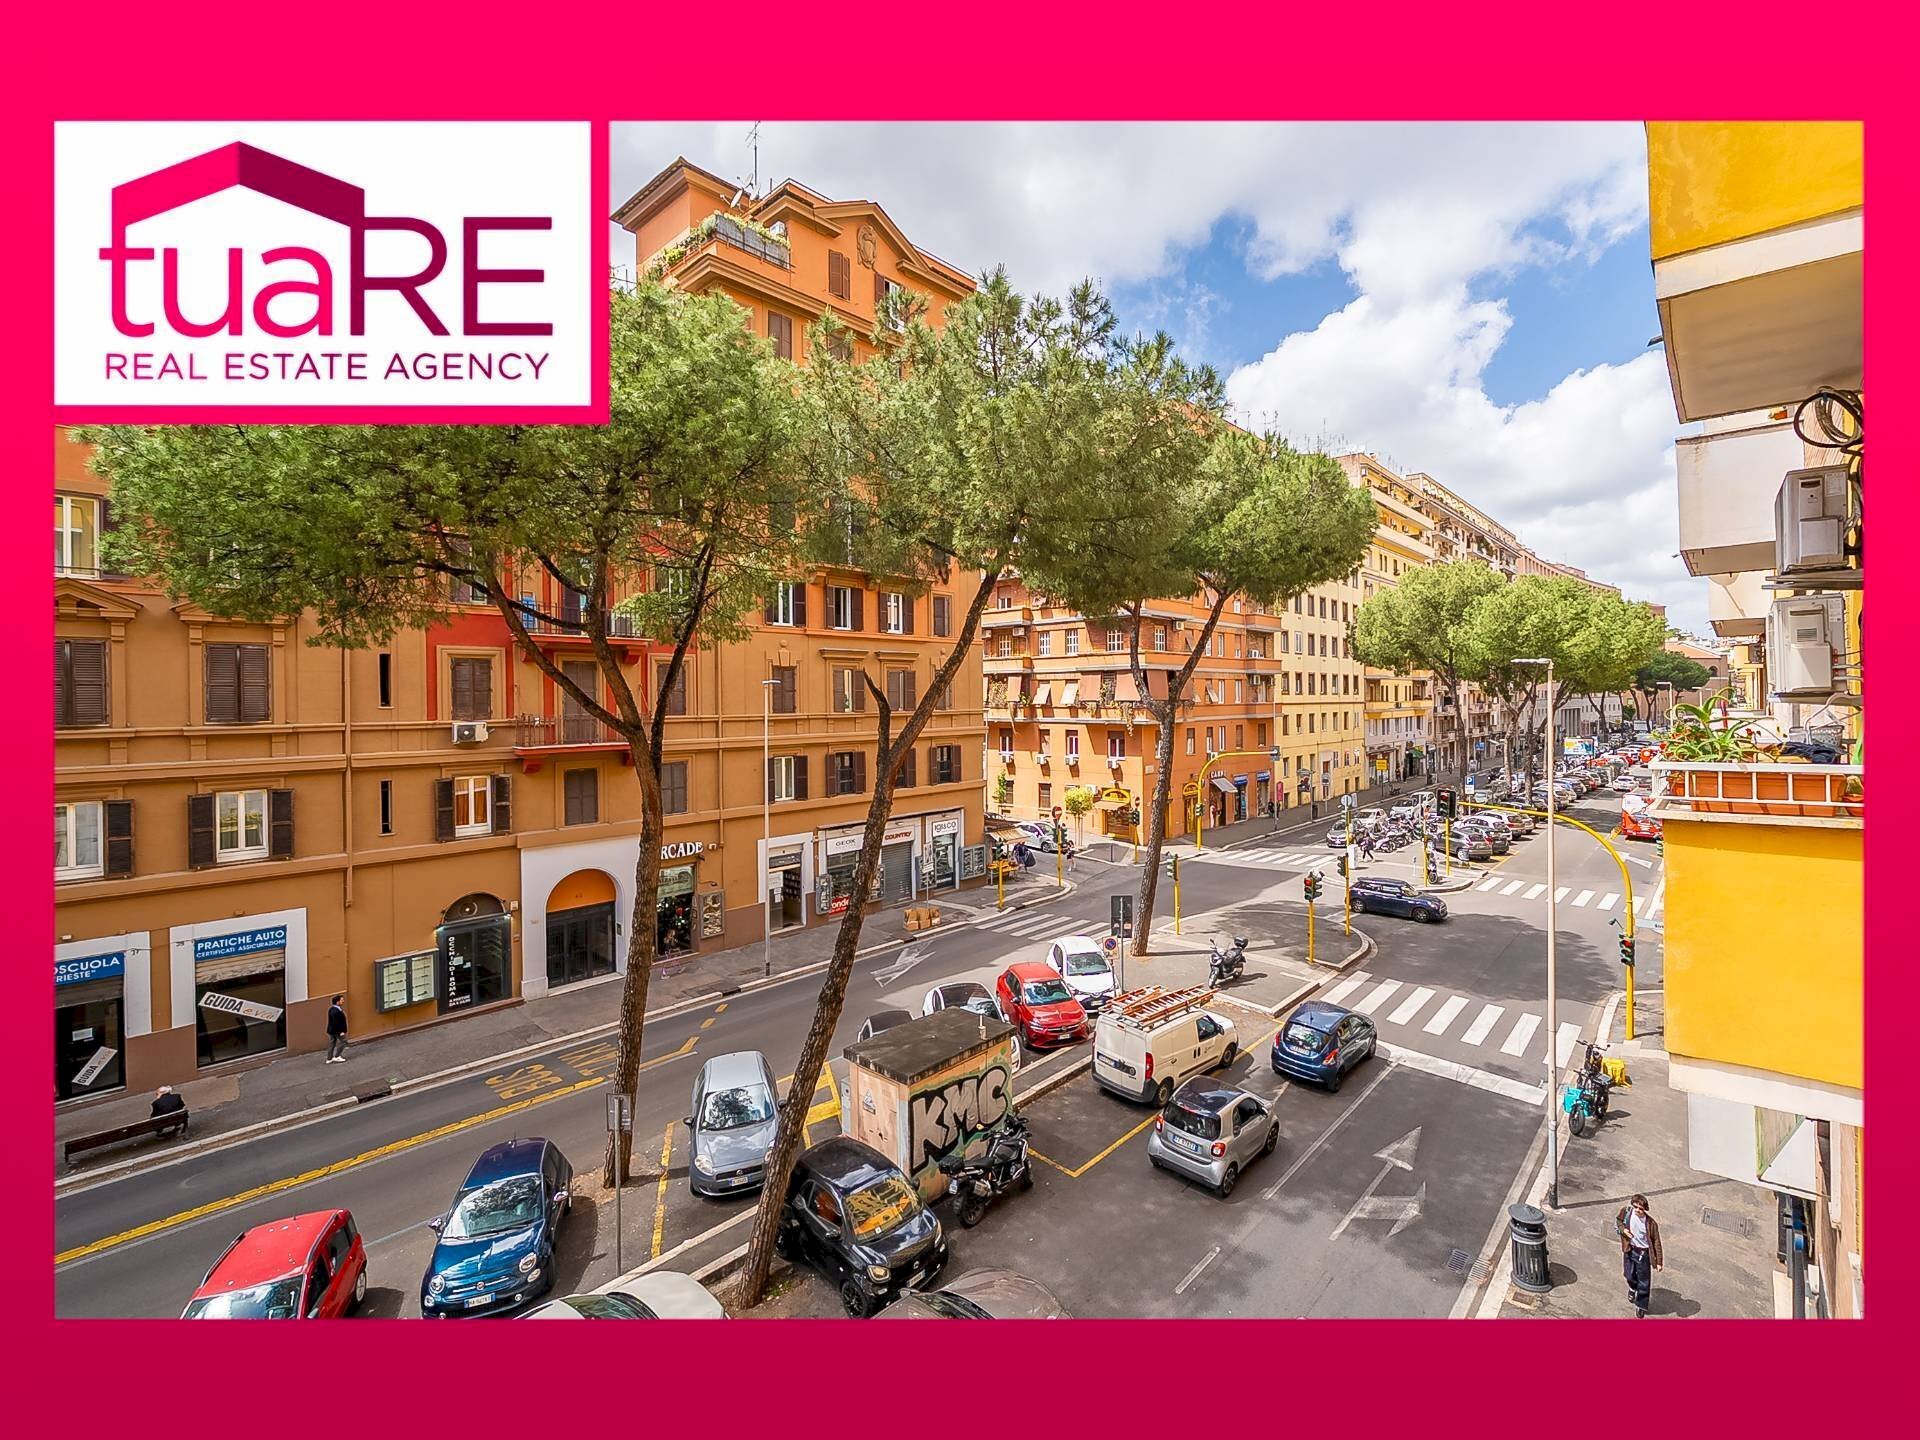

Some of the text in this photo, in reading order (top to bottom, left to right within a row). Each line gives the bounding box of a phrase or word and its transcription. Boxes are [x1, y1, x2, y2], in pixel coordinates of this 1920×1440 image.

[196, 939, 286, 958] CERTIFICATI ASSICURAZIONI
[197, 934, 252, 951] PRATICHE
[255, 929, 285, 942] AUTO
[203, 994, 244, 1013] GUIDA
[77, 1065, 98, 1084] GUIDA
[909, 1066, 1008, 1175] KMC
